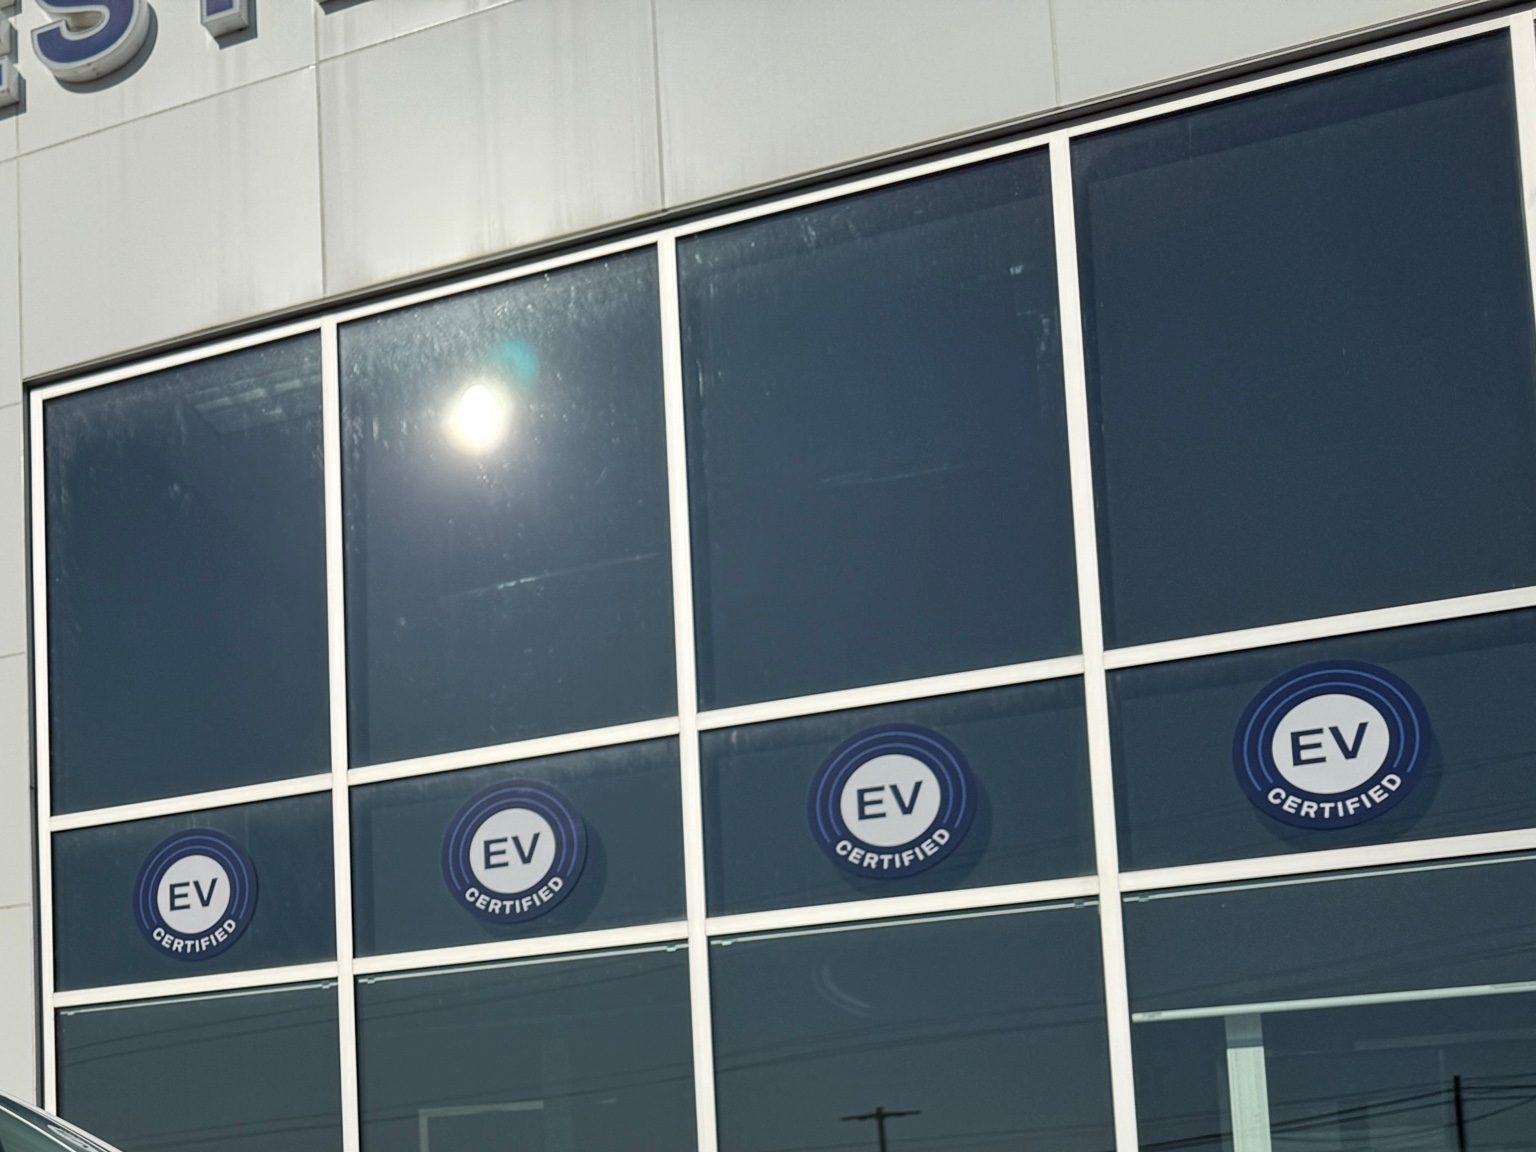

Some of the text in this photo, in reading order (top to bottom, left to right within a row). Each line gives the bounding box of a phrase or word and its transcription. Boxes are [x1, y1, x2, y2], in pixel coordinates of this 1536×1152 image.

[1290, 721, 1369, 767] EV
[856, 780, 923, 821] EV
[1267, 773, 1402, 819] CERTIFIED
[483, 832, 541, 869] EV
[835, 828, 951, 870] CERTIFIED
[169, 877, 218, 912] EV
[465, 876, 563, 915] CERTIFIED
[152, 919, 236, 953] CERTIFIED
